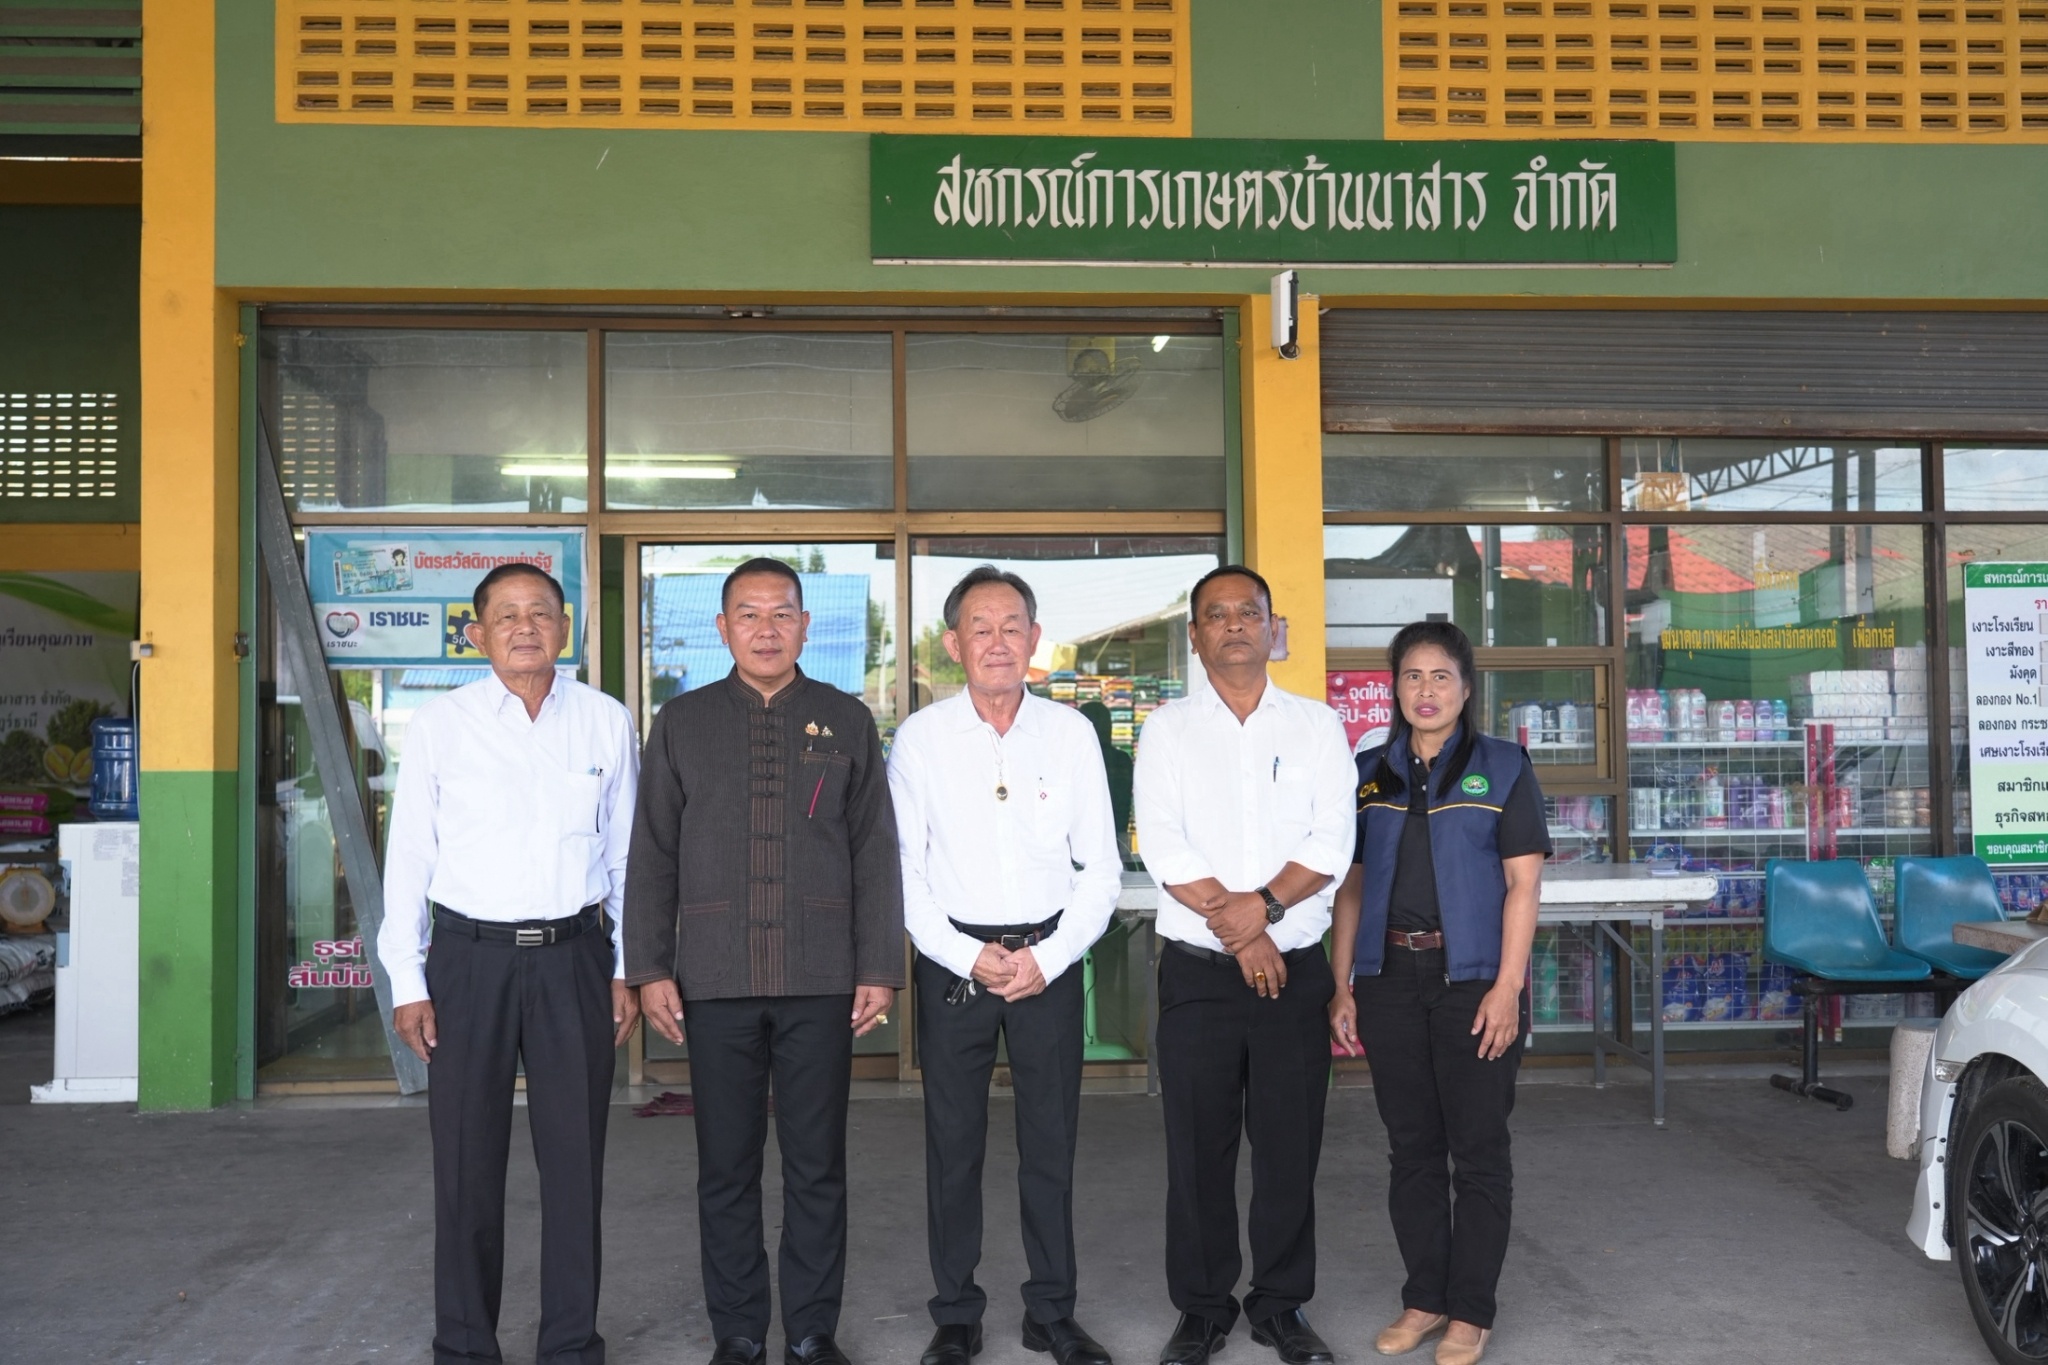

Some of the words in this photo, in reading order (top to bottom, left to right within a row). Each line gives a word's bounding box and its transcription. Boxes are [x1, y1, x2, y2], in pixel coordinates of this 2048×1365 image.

[933, 151, 1489, 232] สหกรณ์การเกษตรบ้านนาสาร
[1511, 154, 1617, 232] จำกัด
[1983, 568, 2048, 584] สหกรณ์การเ
[369, 611, 429, 627] เราชนะ
[1972, 615, 2034, 632] เงาะโรงเรียน
[0, 627, 94, 653] เรียนคุณภาพ
[326, 640, 358, 648] เราชนะ
[1985, 641, 2034, 657] เงาะสีทอง
[2009, 664, 2037, 685] มังคุด
[1976, 695, 2012, 706] ลองกอง
[2015, 693, 2037, 705] No.1
[1978, 720, 2017, 731] ลองกอง
[1995, 807, 2048, 829] ธุรกิจสห
